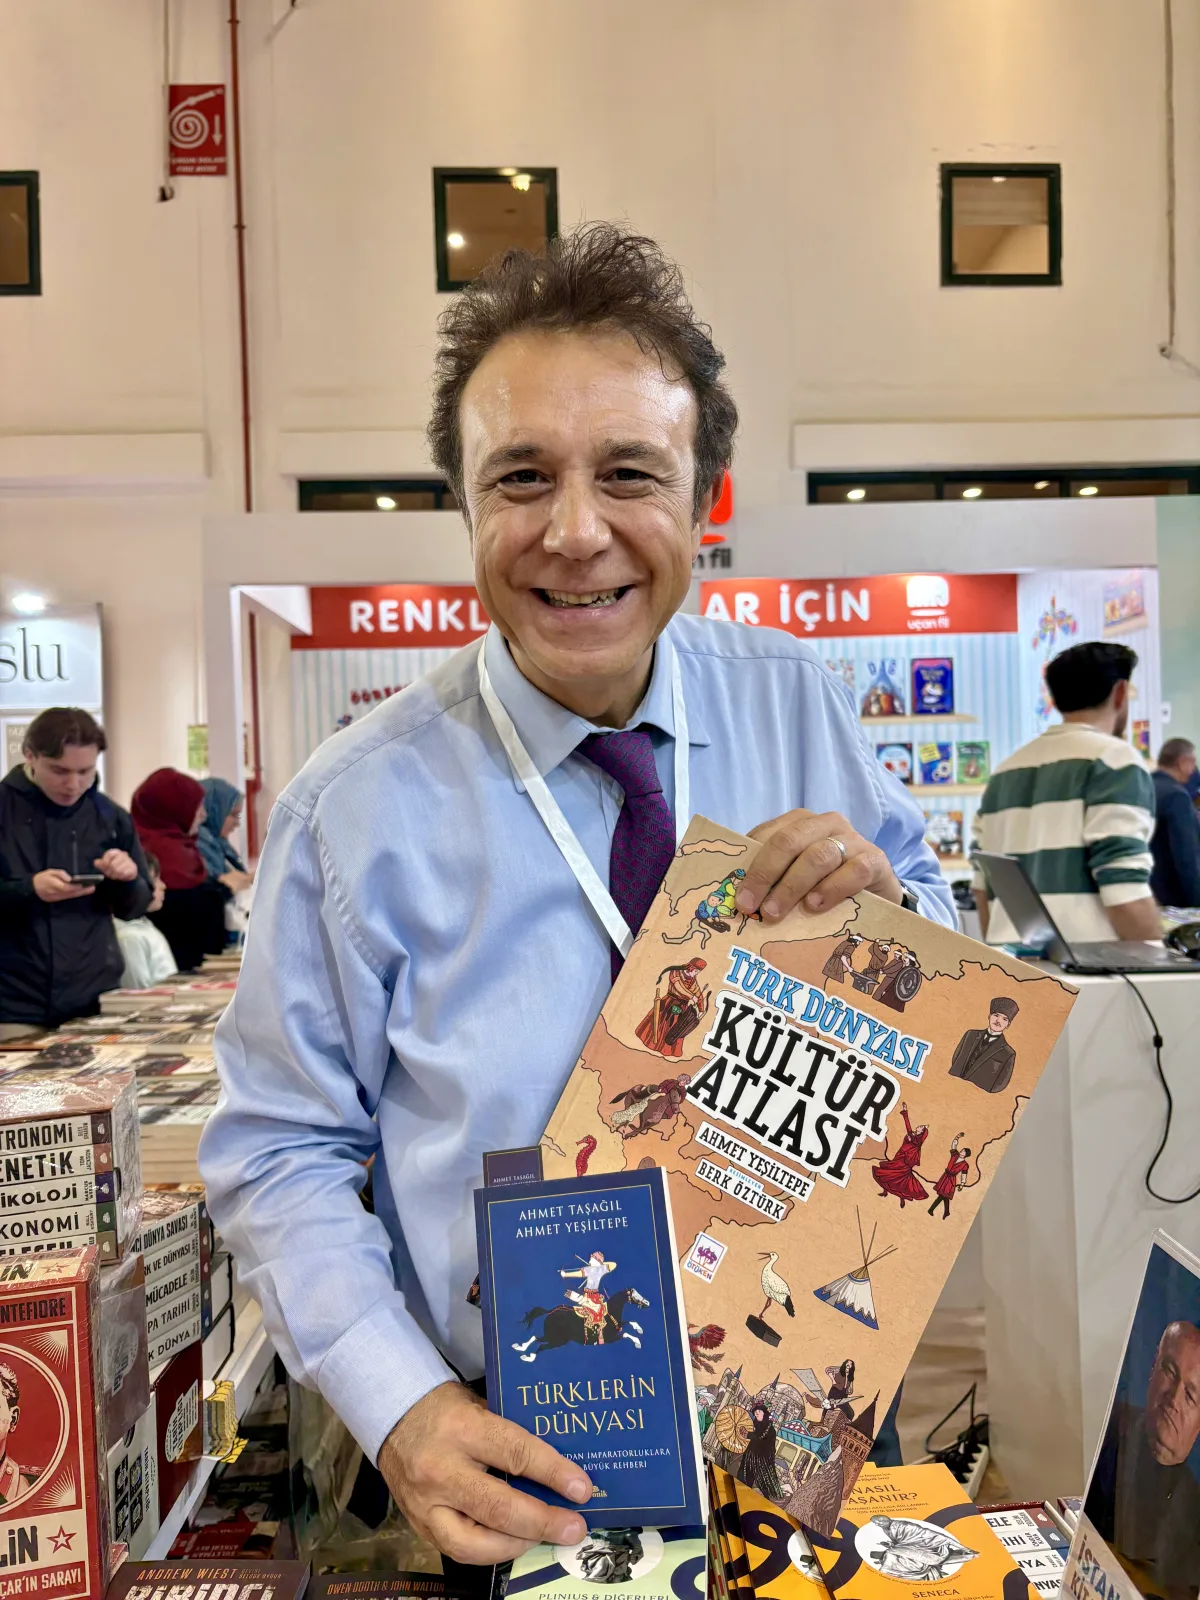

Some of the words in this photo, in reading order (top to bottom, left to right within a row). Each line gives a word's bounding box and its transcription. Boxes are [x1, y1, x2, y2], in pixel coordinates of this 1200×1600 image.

[350, 599, 489, 633] RENKL
[704, 592, 760, 625] AR
[779, 583, 870, 632] İÇİN
[907, 618, 936, 631] uçan
[937, 617, 950, 629] fil
[0, 627, 70, 684] slu
[727, 948, 804, 1014] TÜRK
[800, 989, 929, 1077] DÜNYASI
[707, 997, 897, 1136] KÜLTÜR
[686, 1055, 862, 1181] ATLASI
[699, 1127, 747, 1162] AHMET
[747, 1151, 810, 1197] YEŞİLTEPE
[492, 1175, 512, 1184] AHMET
[698, 1161, 733, 1190] BERK
[733, 1181, 785, 1219] ÖZTÜRK
[519, 1206, 564, 1221] AHMET
[568, 1200, 622, 1216] TAŞAĞIL
[143, 1225, 165, 1250] DÜNYA
[516, 1223, 560, 1239] AHMET
[565, 1216, 629, 1234] YEŞİLTEPE
[153, 1258, 162, 1272] VE
[163, 1250, 191, 1267] DÜNYASI
[686, 1260, 713, 1281] ÖTÜKEN
[145, 1273, 188, 1308] MÜCADELE
[161, 1297, 190, 1326] TARİHİ
[157, 1330, 191, 1357] DÜNYA
[517, 1374, 656, 1408] TÜRKLERİN
[534, 1408, 645, 1436] DÜNYASI
[587, 1447, 671, 1459] İMPARATORLUKLARA
[583, 1462, 611, 1471] BÜYÜK
[851, 1484, 901, 1495] NASIL
[41, 1567, 82, 1590] SARAYI
[136, 1568, 194, 1581] ANDREW
[196, 1568, 238, 1580] WIEST
[327, 1582, 352, 1595] OWEN
[390, 1580, 411, 1591] JOHN
[912, 1588, 961, 1599] SENECA
